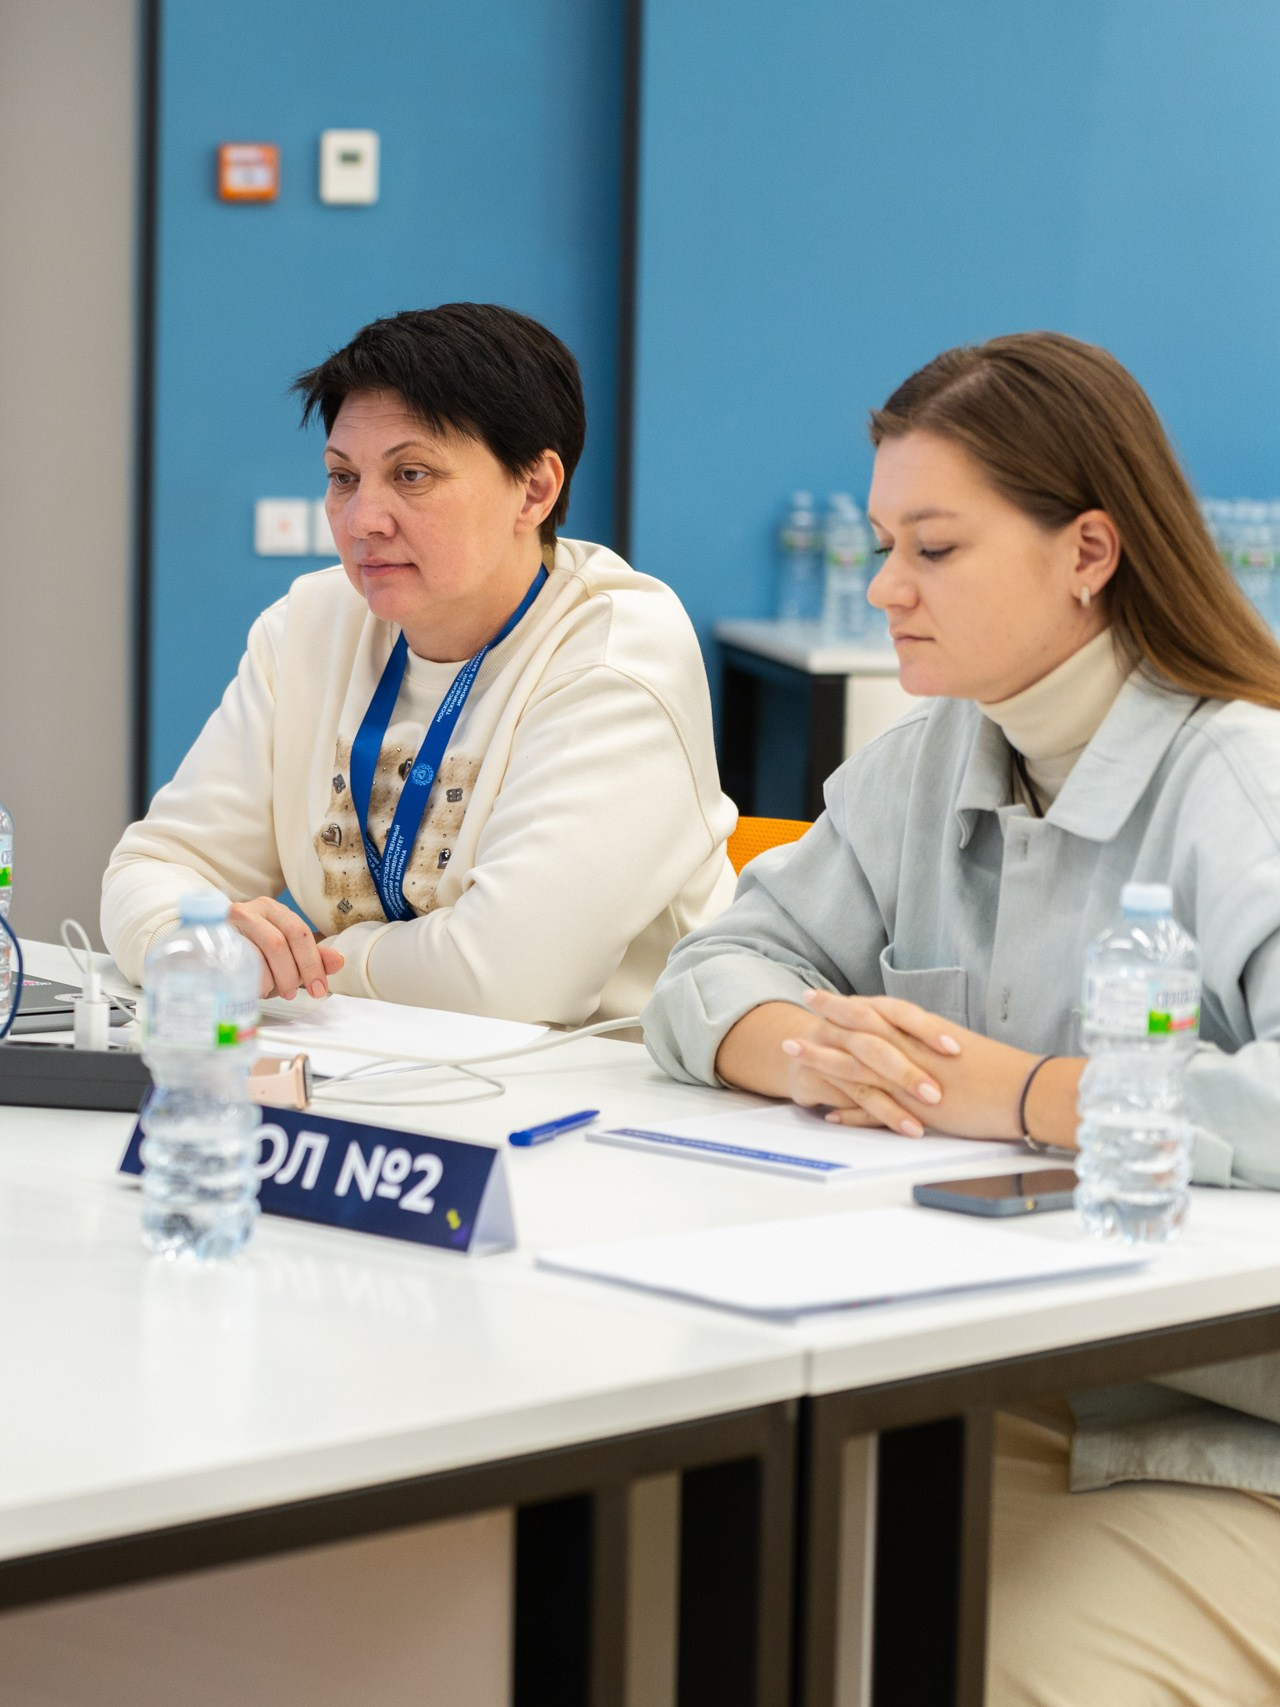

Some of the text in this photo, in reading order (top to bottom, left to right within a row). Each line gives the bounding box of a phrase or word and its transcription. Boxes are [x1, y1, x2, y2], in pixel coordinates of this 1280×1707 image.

[436, 681, 459, 722] МОСКОВСКИЙ
[446, 673, 468, 715] ТЕХНИЧЕСКИЙ
[457, 684, 470, 706] ИМЕНИ
[383, 824, 400, 887] ГОСУДАРСТВЕННЫЙ
[390, 835, 405, 880] УНИВЕРСИТЕТ
[396, 849, 408, 881] БАУМАНА
[256, 1123, 444, 1215] ОЛ №2
